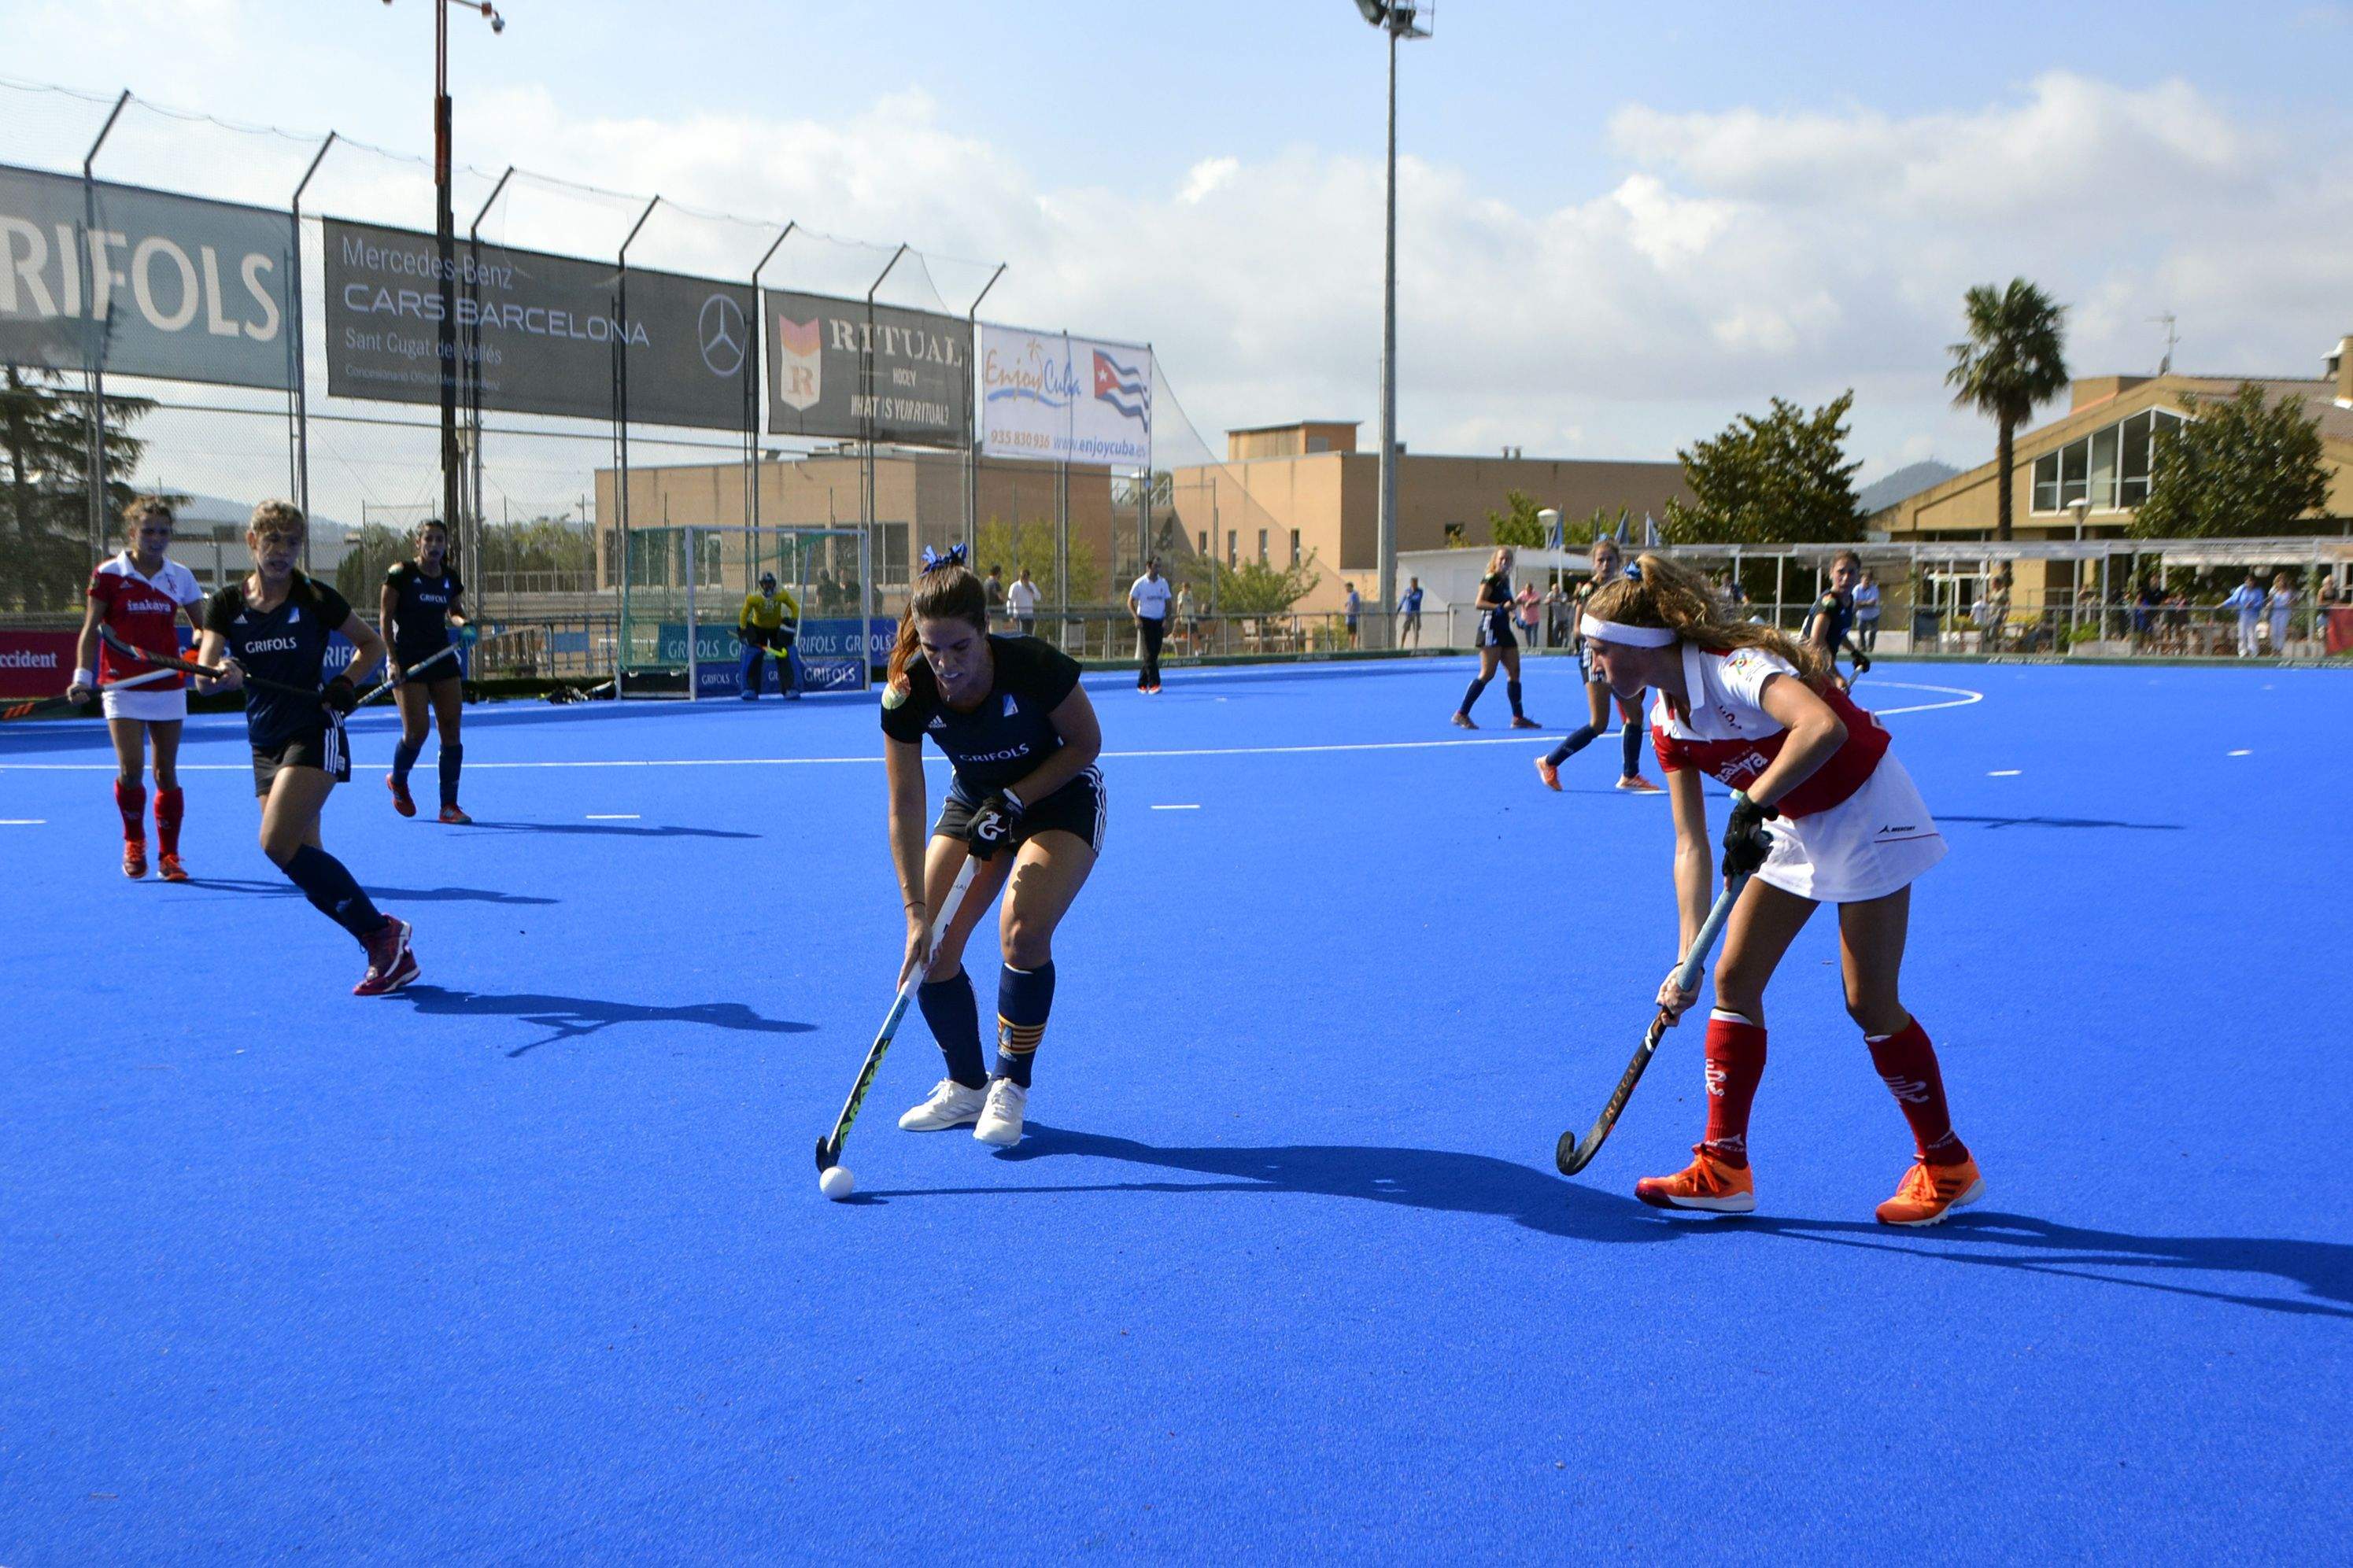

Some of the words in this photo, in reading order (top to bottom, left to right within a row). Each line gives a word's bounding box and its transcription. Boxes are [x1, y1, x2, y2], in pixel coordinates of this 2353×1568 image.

[343, 235, 512, 290] Mercedes-Benz
[0, 216, 281, 341] RIFOLS
[345, 283, 445, 321] CARS
[456, 297, 650, 348] BARCELONA
[345, 327, 382, 352] Sant
[386, 331, 430, 360] Cugat
[829, 318, 962, 367] RITUAL
[984, 349, 1044, 402] Enjoy
[1044, 359, 1083, 396] Cuba
[851, 394, 880, 419] WHAT
[881, 397, 893, 421] IS
[990, 430, 1012, 445] 935
[1033, 434, 1051, 448] 936
[245, 636, 297, 655] GRIFOLS
[668, 639, 719, 659] GROLS
[799, 635, 837, 654] RIFOLS
[701, 673, 730, 685] GRIFOLS
[804, 666, 855, 682] GRIFOLS
[959, 743, 1030, 762] GRIFOLS
